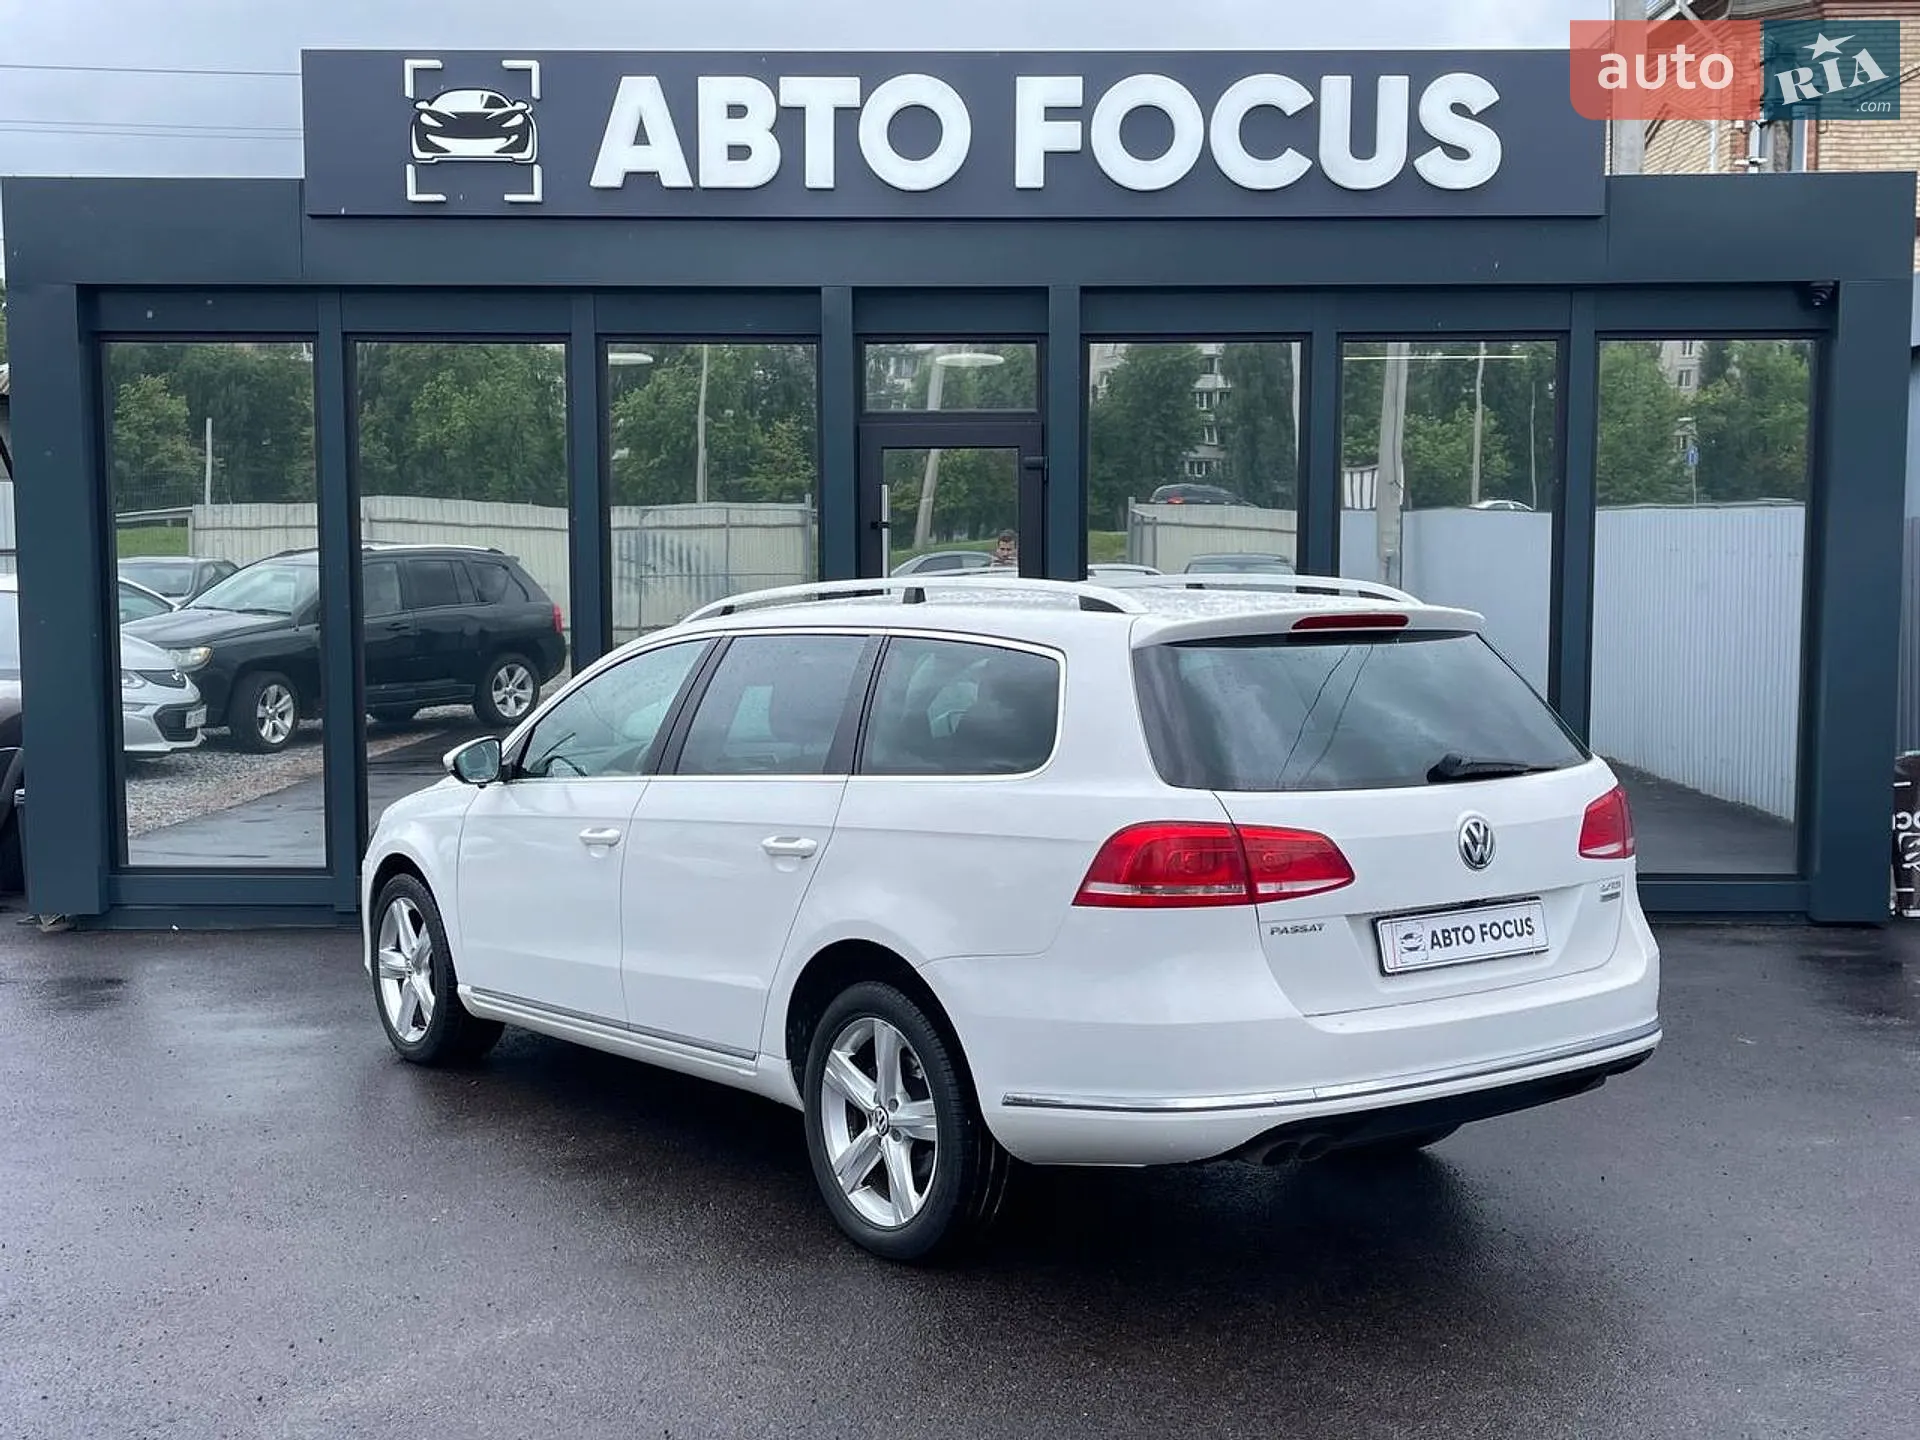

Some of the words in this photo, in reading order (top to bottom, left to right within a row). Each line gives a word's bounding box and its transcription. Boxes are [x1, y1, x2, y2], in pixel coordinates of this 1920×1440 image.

[590, 74, 971, 189] АВТО
[1016, 73, 1502, 190] FOCUS
[1270, 922, 1325, 936] PASSAT
[1430, 925, 1475, 949] АВТО
[1479, 917, 1535, 943] FOCUS
